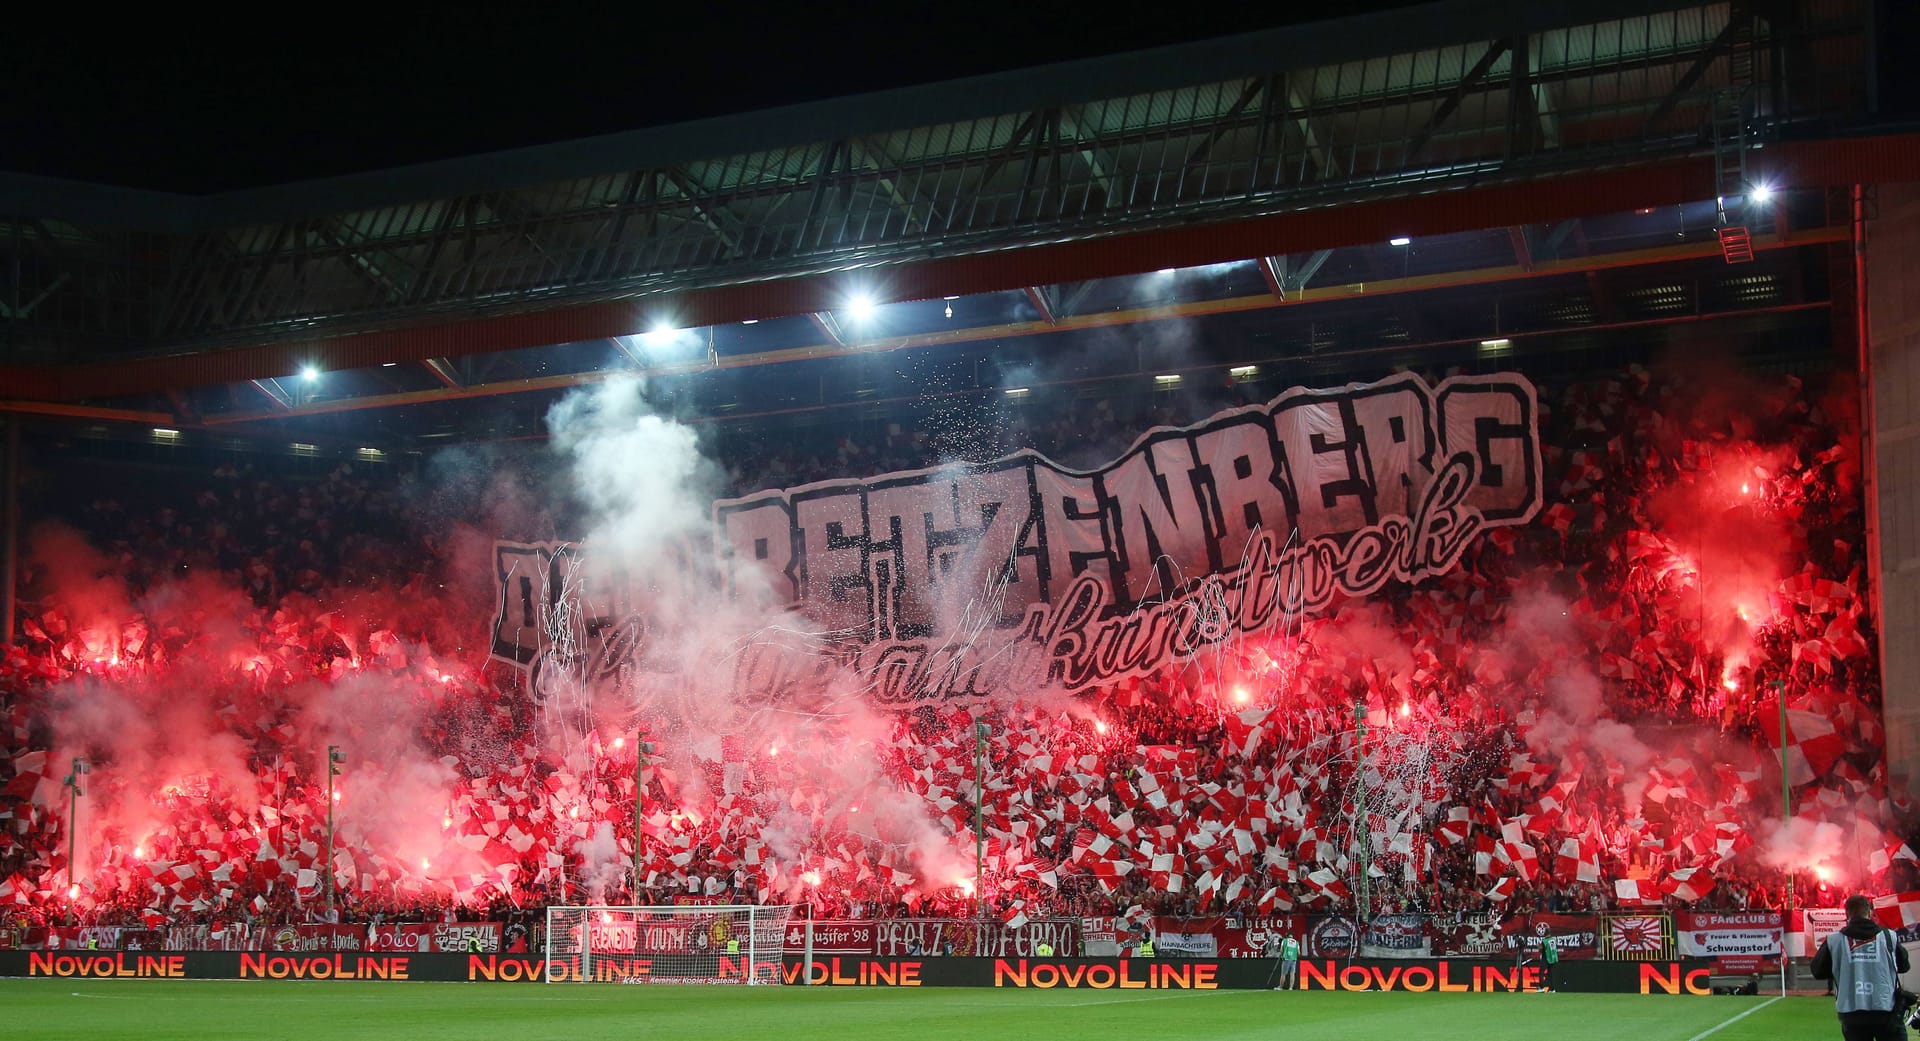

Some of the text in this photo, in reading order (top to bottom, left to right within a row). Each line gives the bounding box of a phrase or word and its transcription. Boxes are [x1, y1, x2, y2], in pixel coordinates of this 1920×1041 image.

[713, 370, 1542, 650] BETZENBERG
[1710, 915, 1765, 924] FANCLUB
[644, 927, 686, 951] YOUTH
[812, 928, 850, 944] uzifer
[851, 928, 869, 942] '98
[1527, 935, 1543, 946] SIN
[448, 940, 498, 952] COPS
[1706, 943, 1772, 953] Schwagstorf
[1855, 982, 1874, 995] 29
